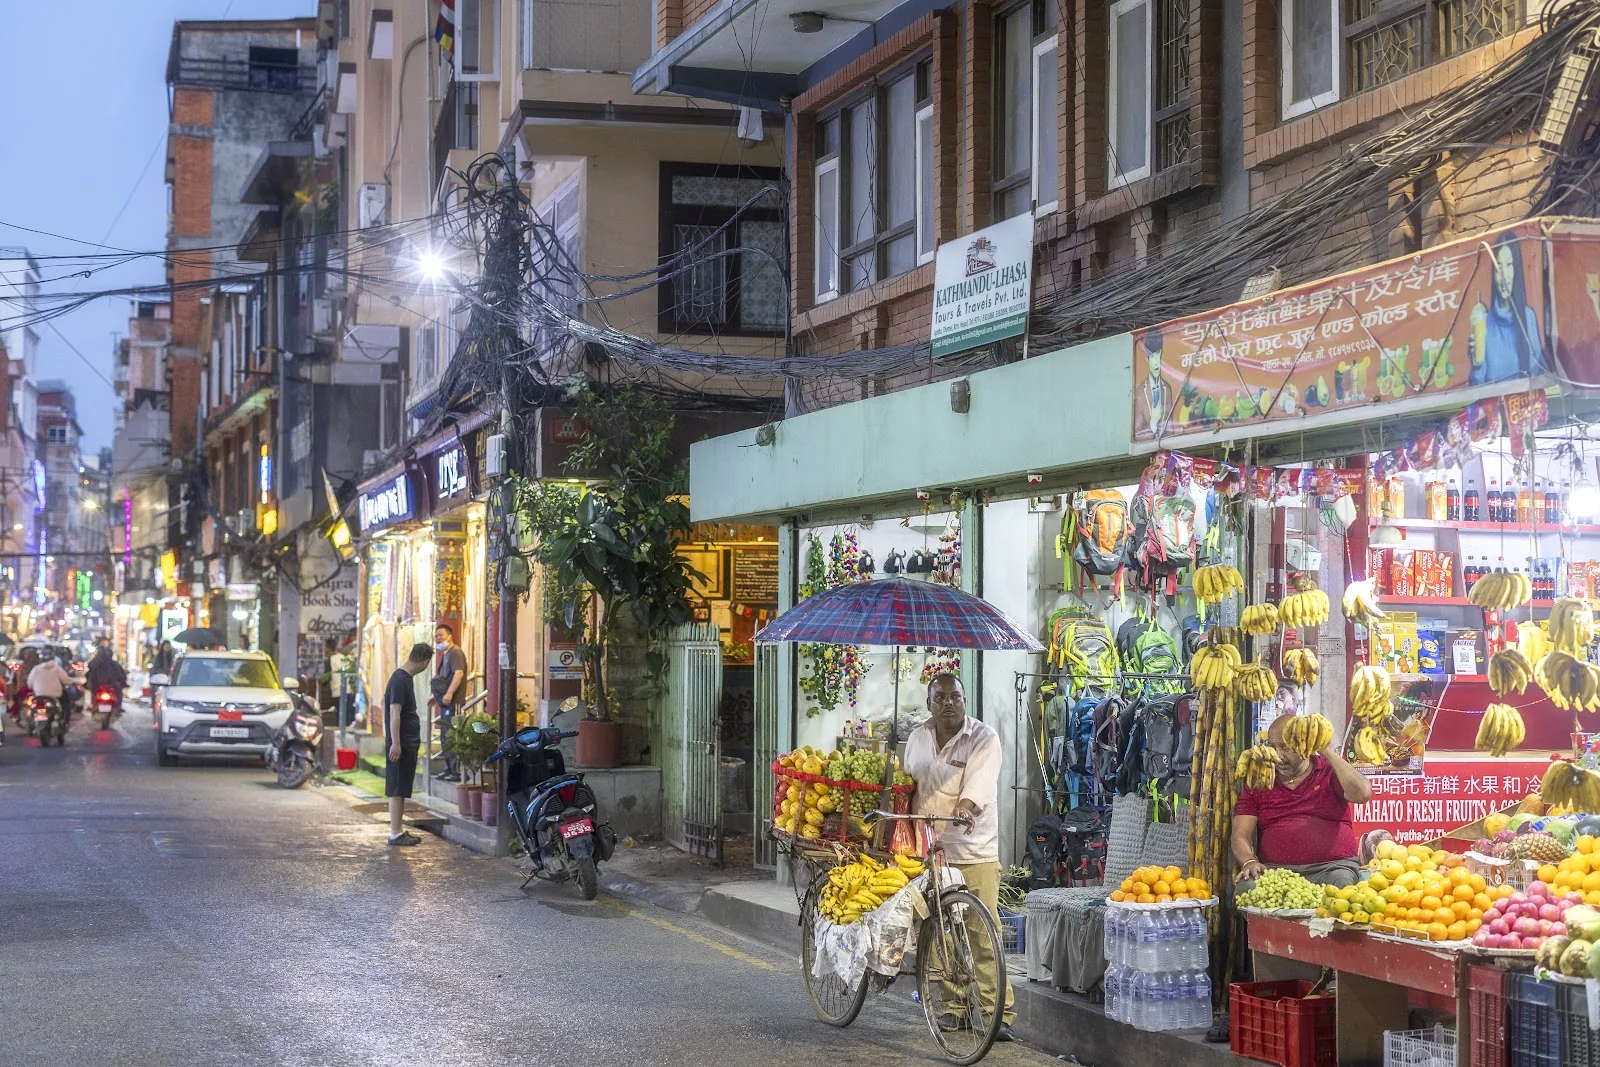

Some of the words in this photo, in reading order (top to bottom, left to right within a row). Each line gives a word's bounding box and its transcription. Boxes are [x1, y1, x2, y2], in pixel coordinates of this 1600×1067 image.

[936, 261, 1028, 308] KATHMANDU-LHASA
[935, 311, 953, 324] Tours
[956, 304, 962, 318] &
[965, 297, 992, 314] Travels
[994, 291, 1009, 306] Pvt.
[1012, 283, 1027, 300] Ltd.
[1182, 257, 1460, 343] 马哈托新鲜果汁及冷库
[1414, 290, 1460, 317] स्टोर
[302, 592, 332, 607] Book
[334, 594, 357, 608] Sho
[1423, 775, 1460, 795] 新鲜
[1463, 775, 1500, 795] 水果
[1503, 776, 1521, 795] 和
[1353, 800, 1404, 823] MAHATO
[1406, 800, 1444, 823] FRESH
[1446, 799, 1487, 823] FRUITS
